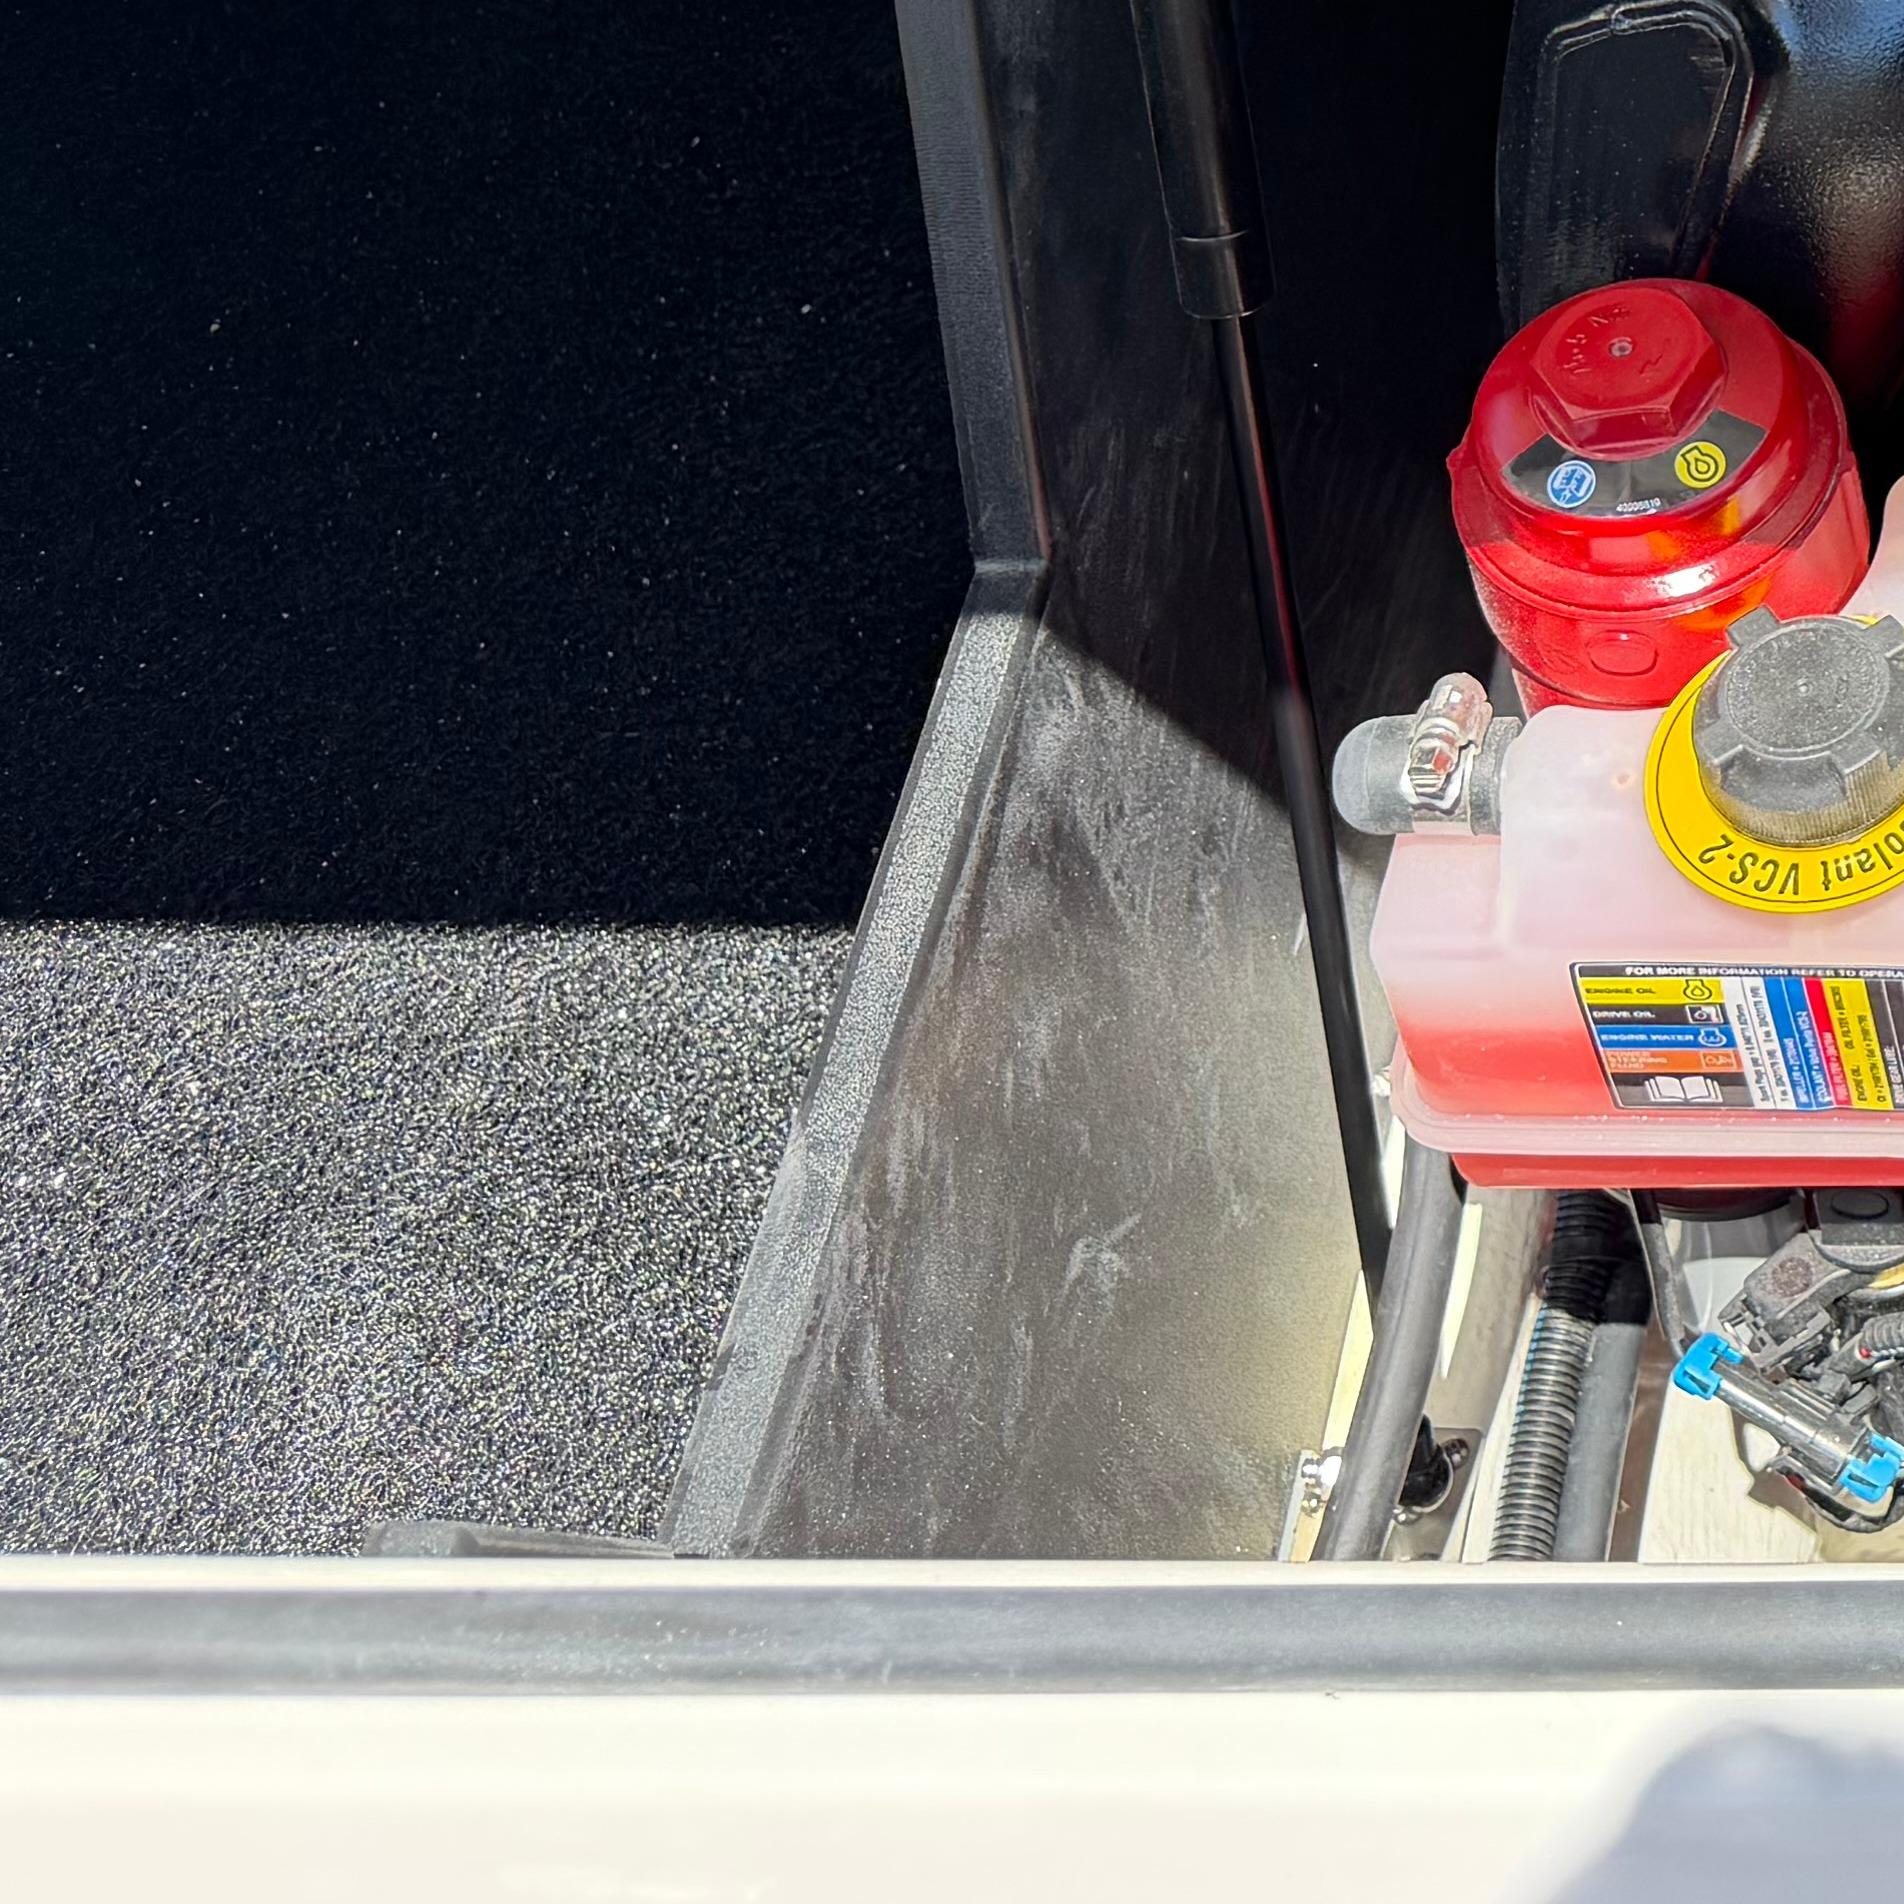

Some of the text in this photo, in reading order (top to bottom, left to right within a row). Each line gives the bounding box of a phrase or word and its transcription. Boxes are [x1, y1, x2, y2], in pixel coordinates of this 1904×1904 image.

[1698, 833, 1800, 896] VCS-2
[1625, 967, 1654, 976] FOR
[1656, 967, 1696, 976] MORE
[1699, 968, 1788, 977] INFORMATION
[1791, 968, 1836, 977] REFER
[1838, 969, 1856, 978] TO
[1585, 987, 1656, 995] ENGINE OIL
[1593, 1010, 1656, 1019] DRIVE OIL
[1601, 1033, 1694, 1042] ENGINE WATER
